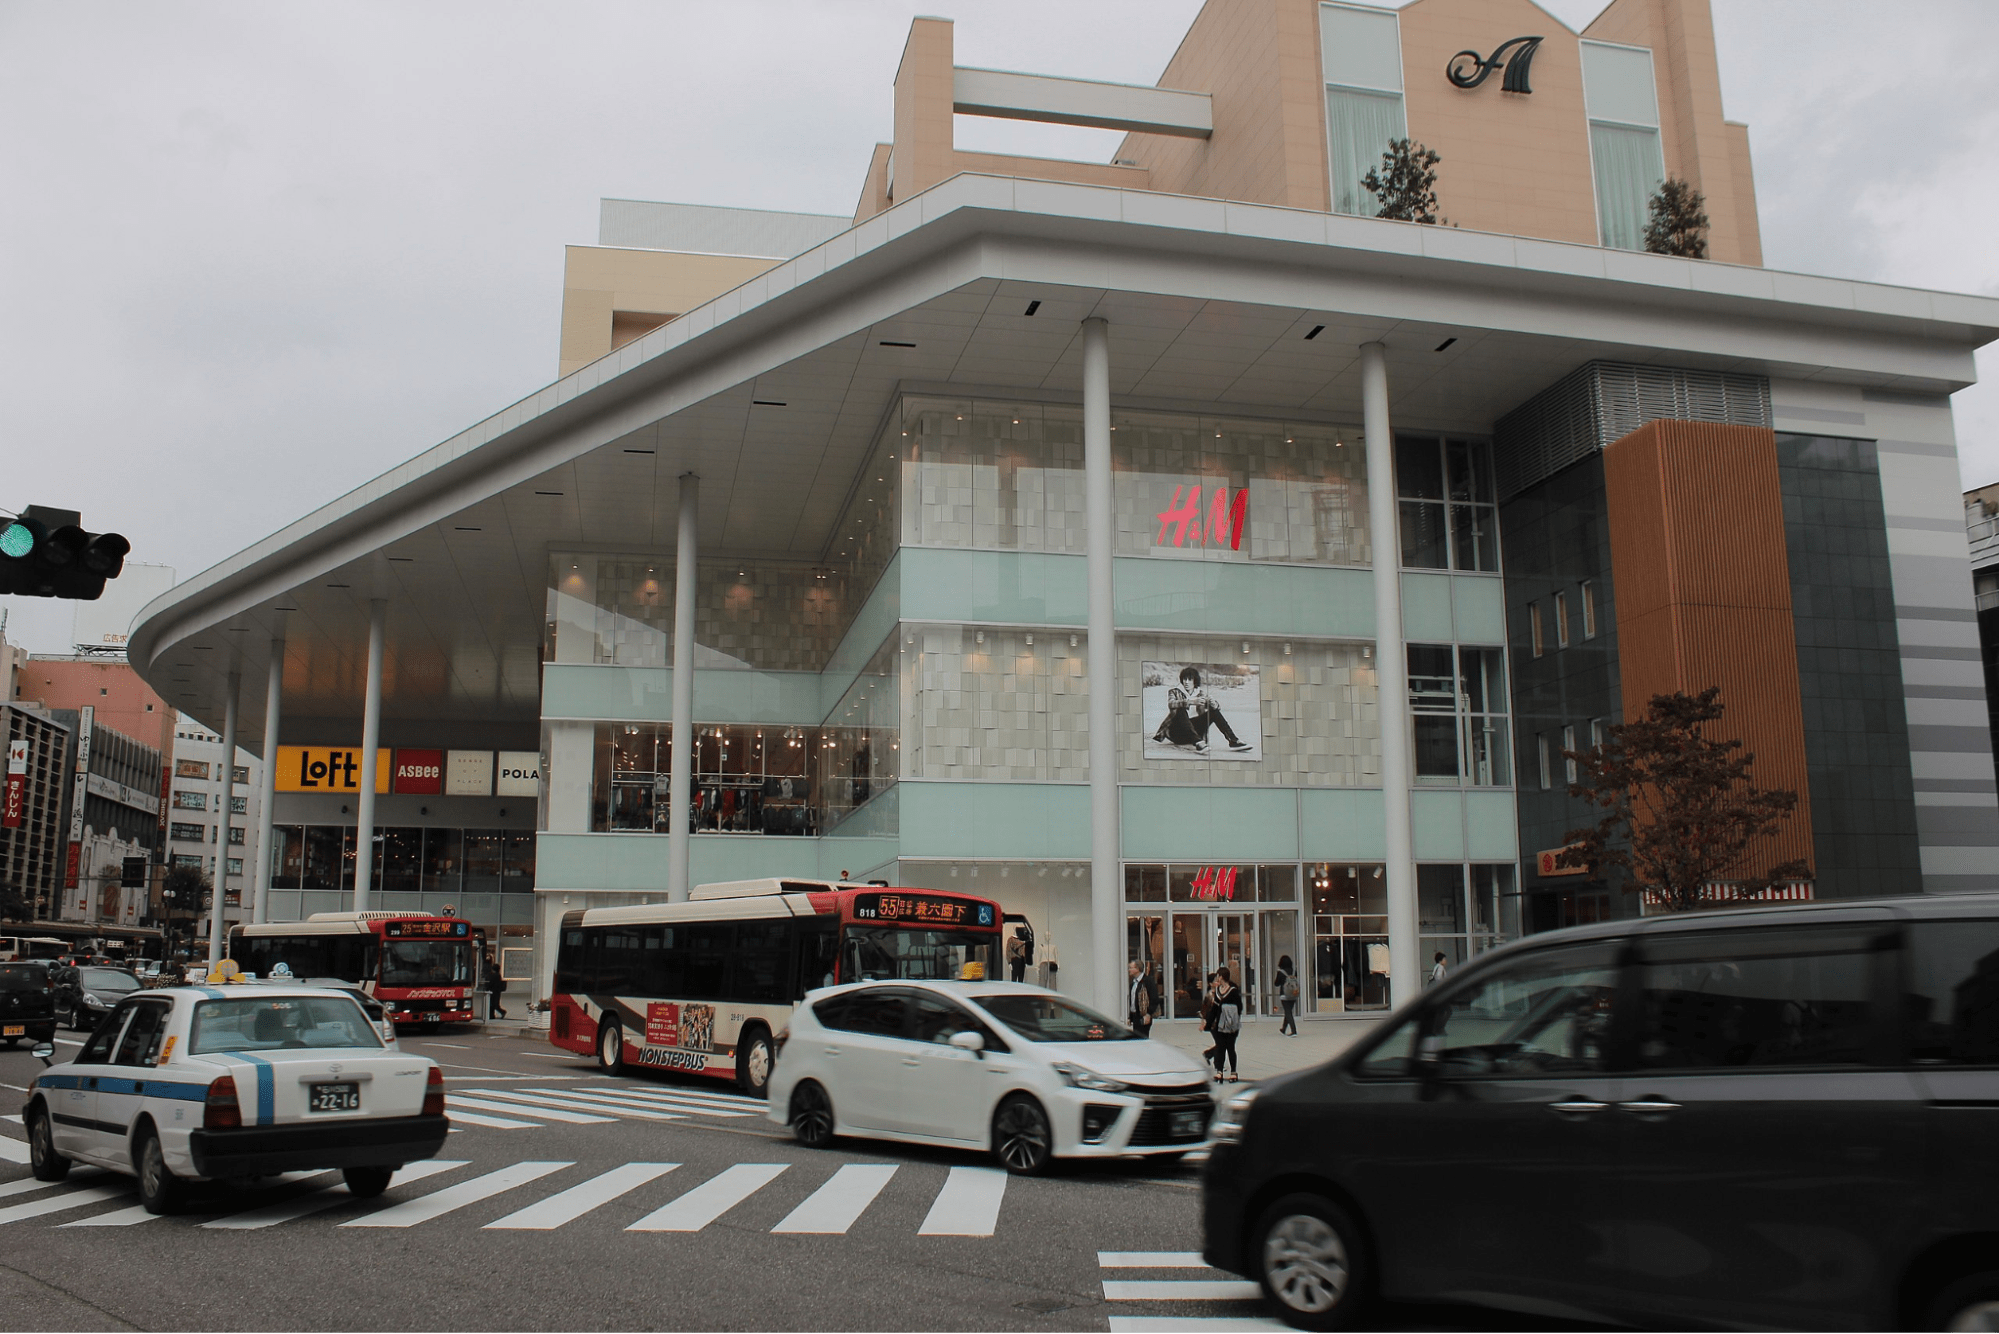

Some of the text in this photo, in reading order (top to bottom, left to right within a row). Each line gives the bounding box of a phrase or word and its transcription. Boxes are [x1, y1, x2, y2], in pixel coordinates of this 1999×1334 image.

[1157, 484, 1249, 551] H&M
[502, 769, 540, 779] POLA
[7, 781, 20, 818] きんしん
[159, 798, 167, 827] SHIDAX
[1189, 866, 1237, 900] H&M
[859, 908, 875, 918] 818
[880, 898, 897, 915] 55
[915, 902, 967, 918] 兼六園下
[402, 923, 411, 934] 25
[319, 1094, 358, 1109] 22-16
